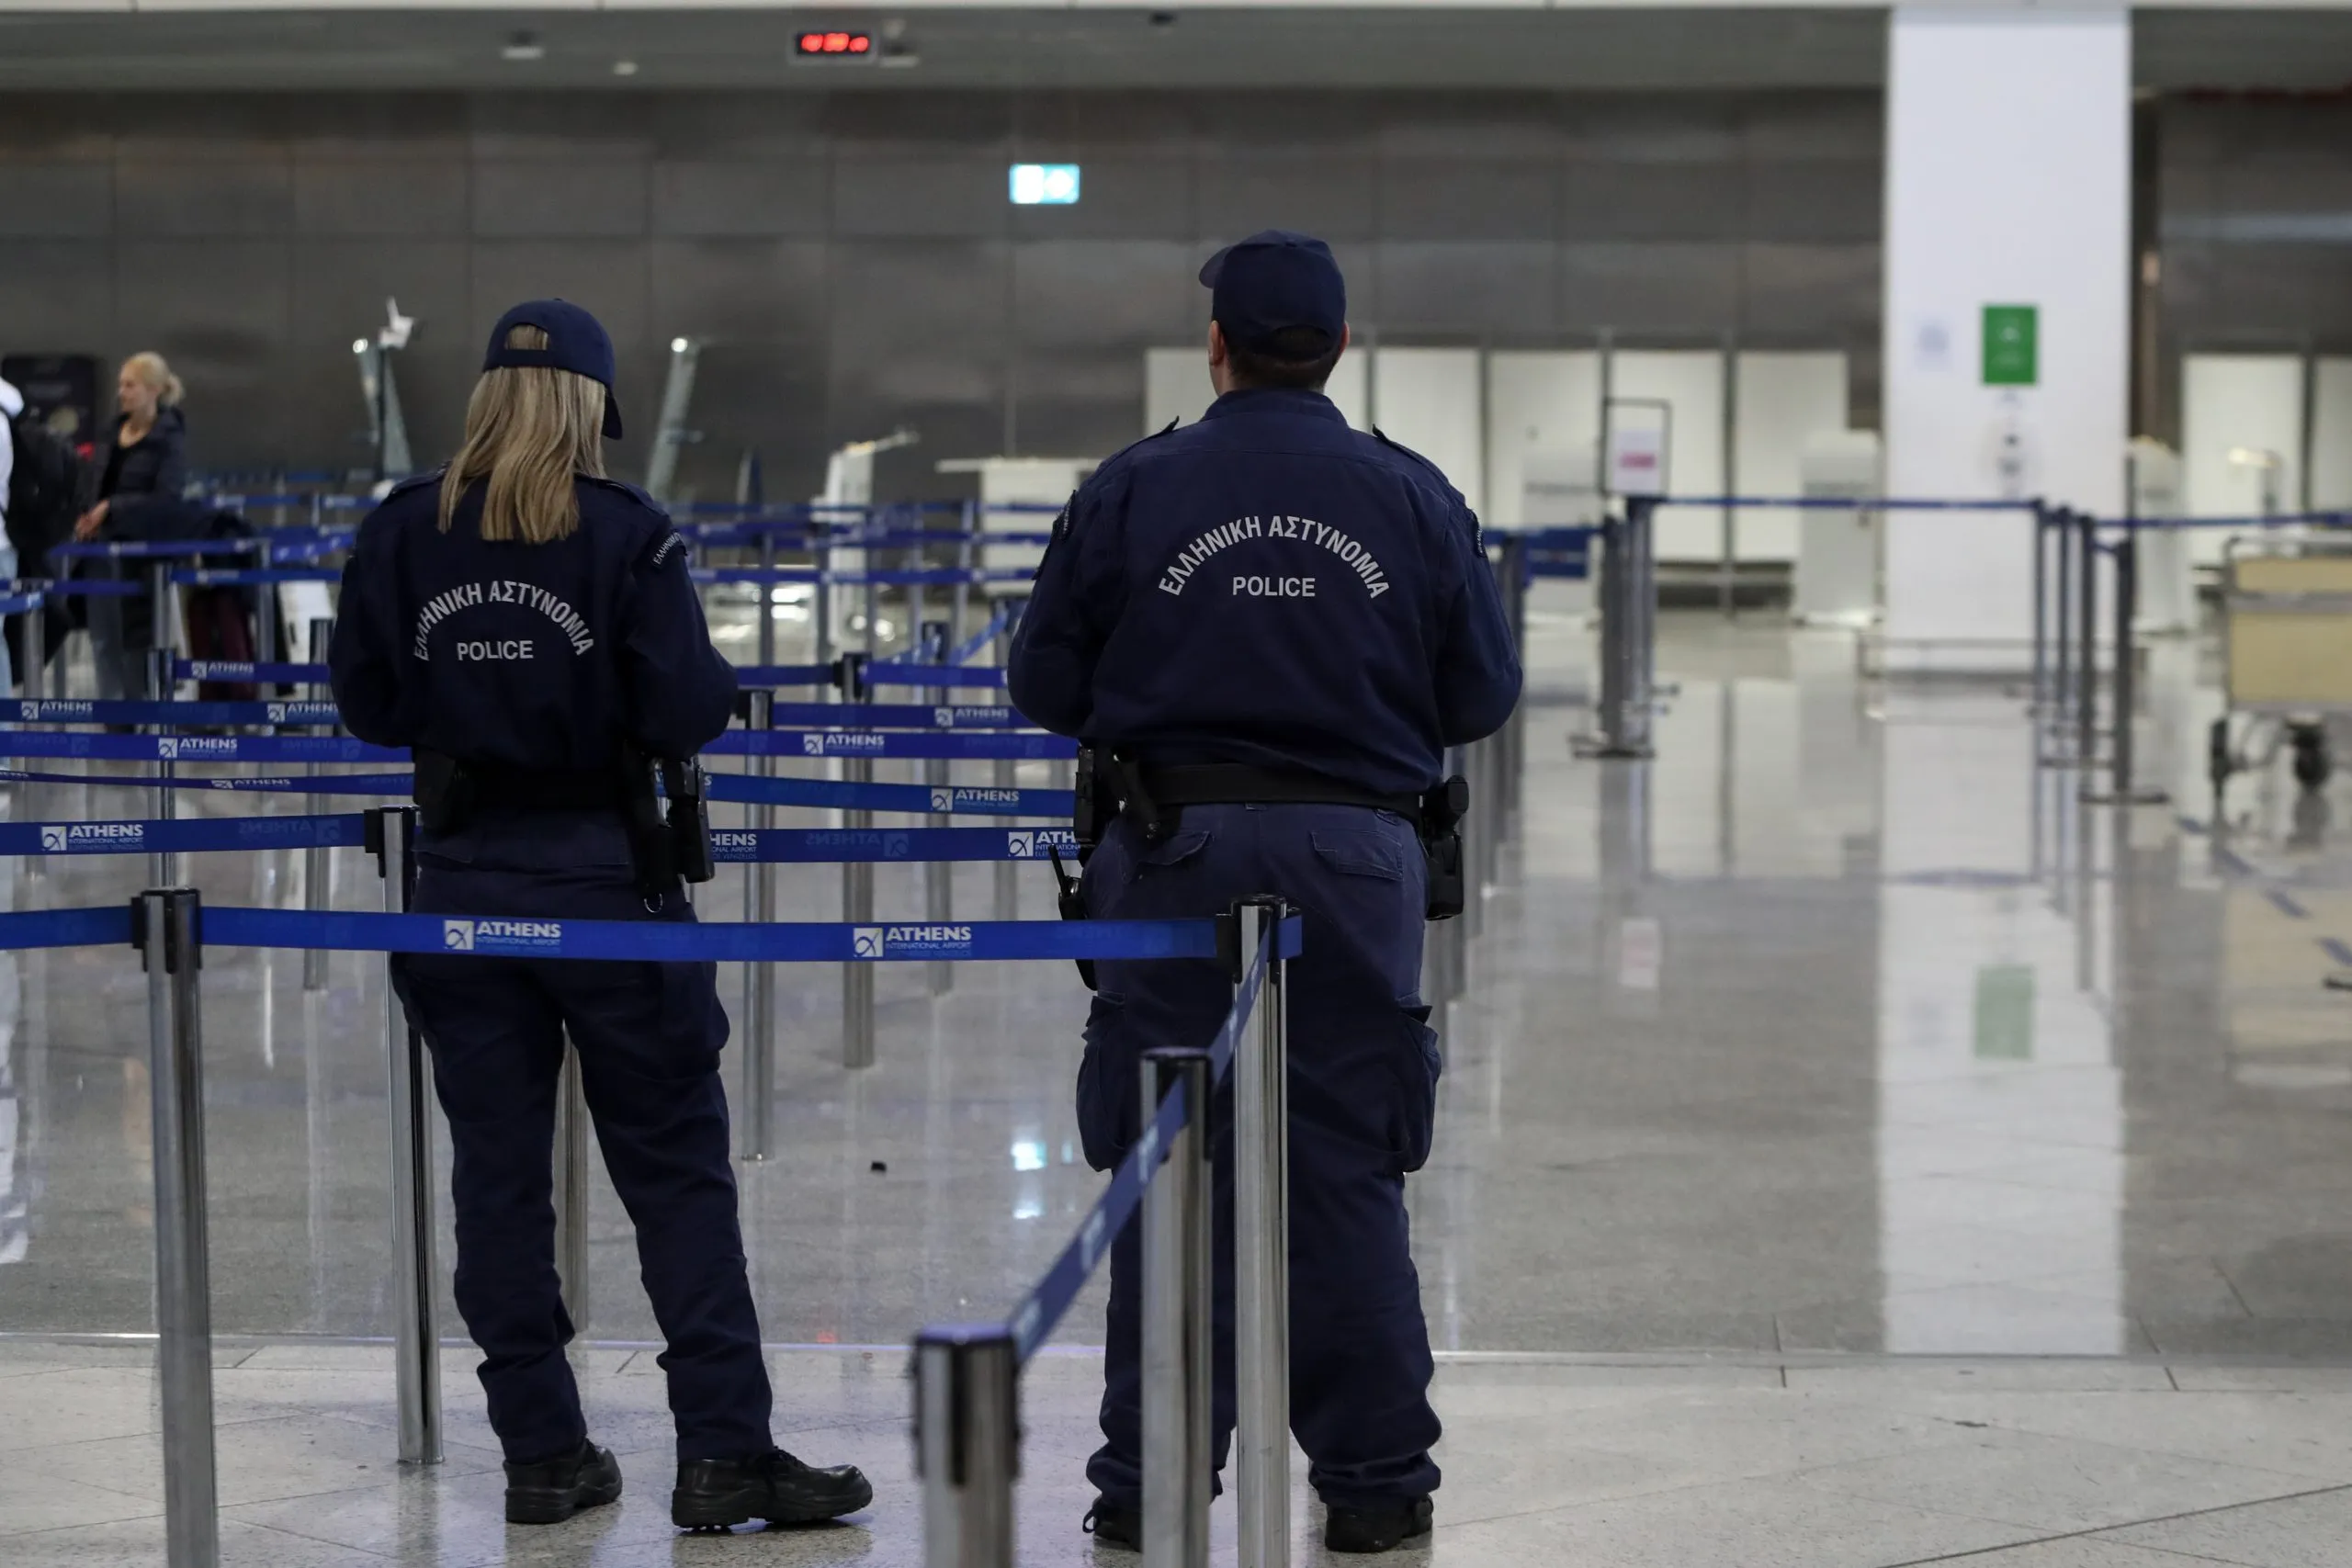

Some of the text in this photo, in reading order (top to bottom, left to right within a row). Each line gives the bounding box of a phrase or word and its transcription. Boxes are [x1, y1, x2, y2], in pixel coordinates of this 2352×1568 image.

[1159, 516, 1261, 595] ΕΛΛΗΝΙΚΗ
[1268, 516, 1389, 598] ΑΣΤΥΝΟΜΙΑ
[1233, 576, 1315, 596] POLICE
[413, 581, 594, 660] ΕΛΛΗΝΙΚΗ ΑΣΤΥΝΟΜΙΑ
[457, 640, 533, 660] POLICE
[208, 661, 254, 673] ATHENS
[40, 701, 93, 712] ATHENS
[954, 707, 1009, 718] ATHENS
[179, 738, 237, 749] ATHENS
[825, 734, 885, 746] ATHENS
[956, 789, 1019, 802] ATHENS
[70, 824, 144, 838] ATHENS
[1036, 830, 1077, 843] ATH
[709, 833, 757, 846] HENS
[477, 920, 561, 938] ATHENS
[886, 926, 971, 942] ATHENS
